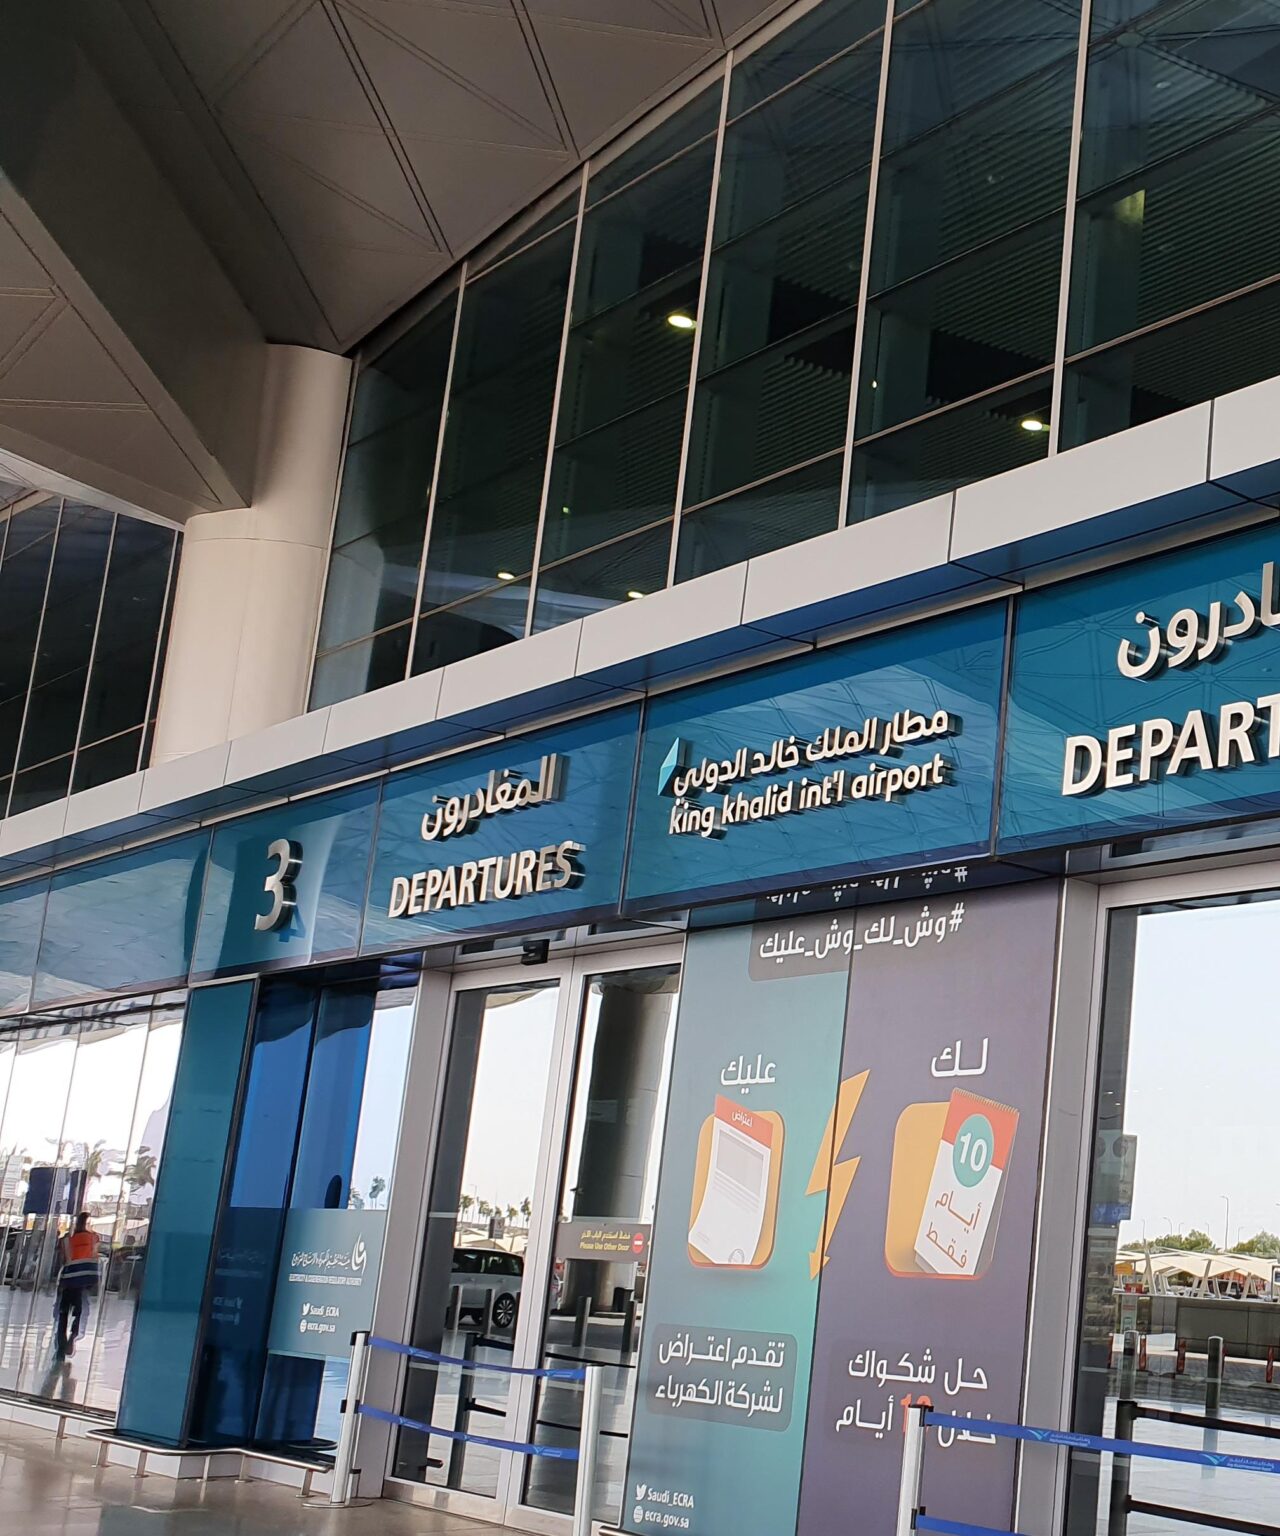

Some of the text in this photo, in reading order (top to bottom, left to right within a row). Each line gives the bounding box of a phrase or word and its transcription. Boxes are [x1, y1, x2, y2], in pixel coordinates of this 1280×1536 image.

[673, 709, 949, 806] مطار الملك خالد الدولي
[421, 752, 562, 841] المغادرون
[721, 780, 794, 825] khalid
[799, 769, 845, 810] int'l
[851, 752, 944, 802] airport
[254, 838, 297, 931] 3
[388, 840, 580, 918] DEPARTURES
[720, 1054, 777, 1094] عليك
[931, 1037, 989, 1078] لك
[960, 1132, 988, 1172] 10
[935, 1190, 982, 1234] أيام
[926, 1221, 967, 1268] فقط
[658, 1332, 785, 1370] تقدم اعتراض
[848, 1348, 988, 1395] حل شكواك
[655, 1375, 784, 1417] لشركة الكهرباء
[836, 1394, 894, 1439] أيام
[644, 1510, 690, 1529] ecra.gov.sa
[647, 1487, 695, 1509] Saudi_ECRA
